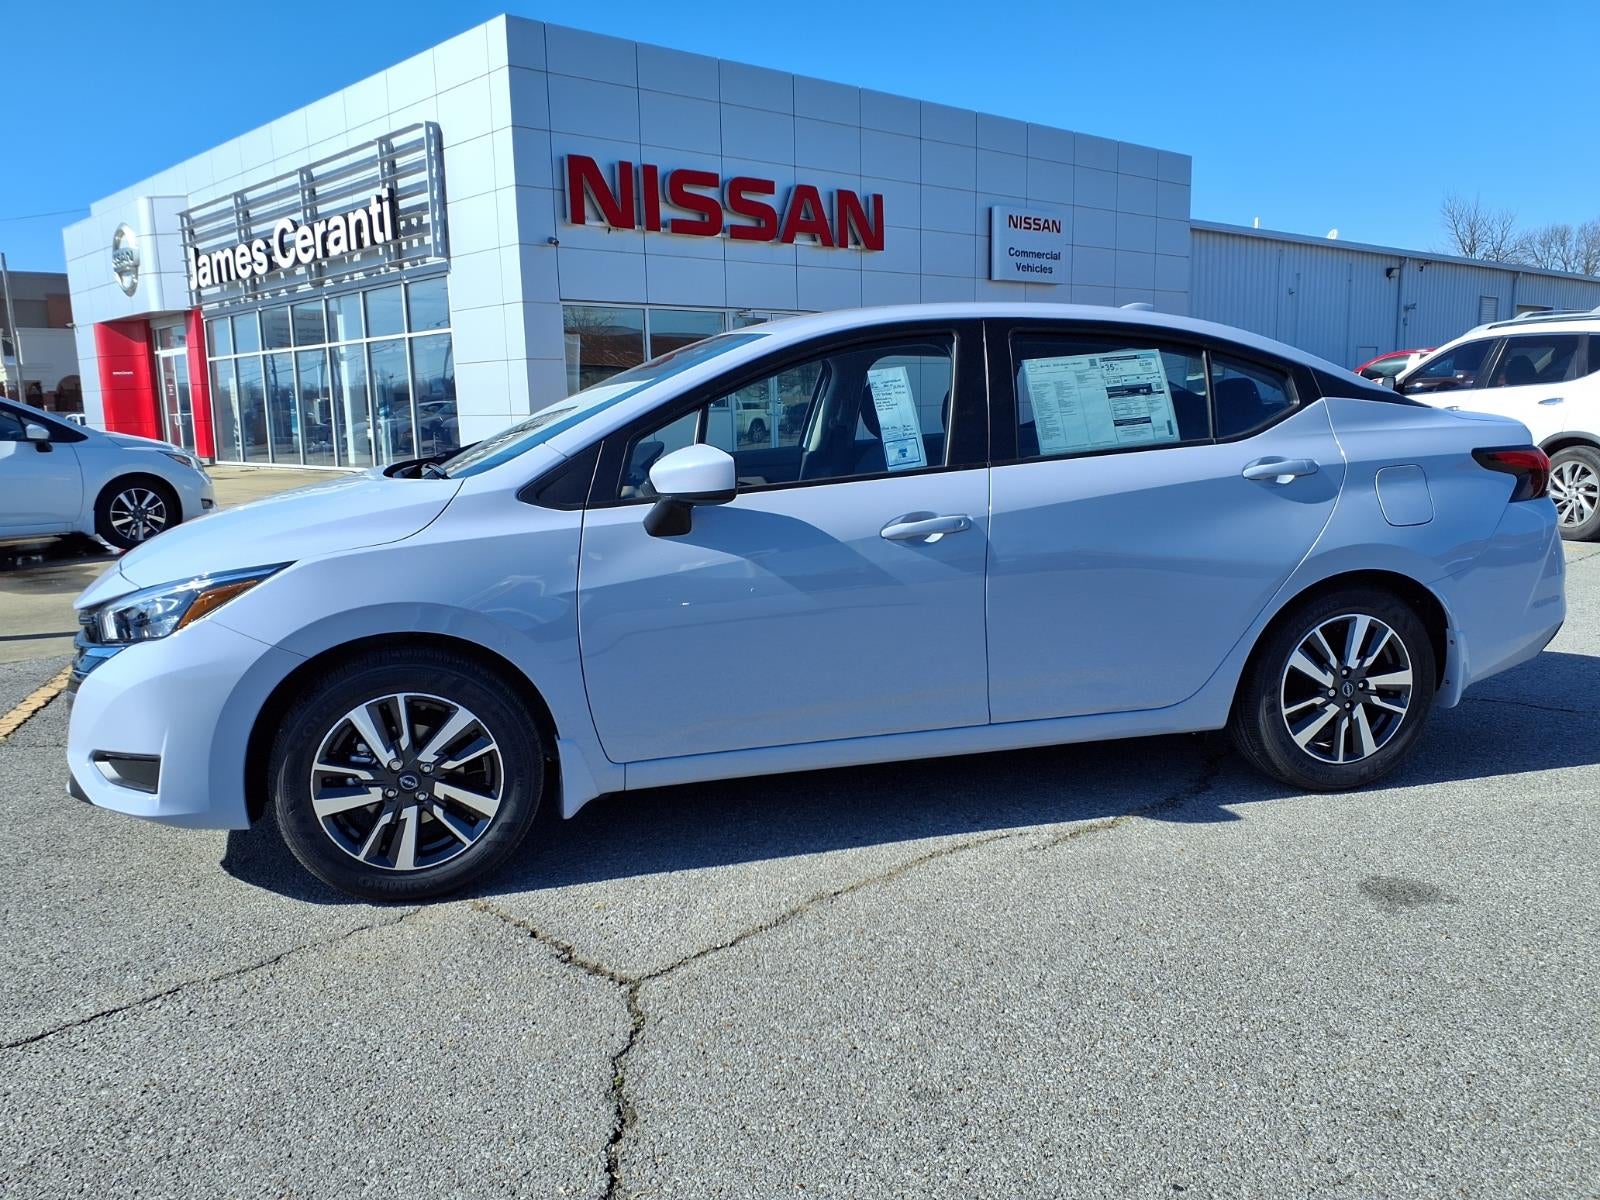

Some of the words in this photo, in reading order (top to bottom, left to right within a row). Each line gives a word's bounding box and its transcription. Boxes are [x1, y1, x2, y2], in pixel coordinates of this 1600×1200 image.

[564, 154, 885, 251] NISSAN
[1008, 214, 1061, 233] NISSAN
[189, 239, 269, 290] James
[273, 188, 394, 269] Ceranti
[1008, 246, 1061, 261] Commercial
[1015, 262, 1053, 274] Vehicles
